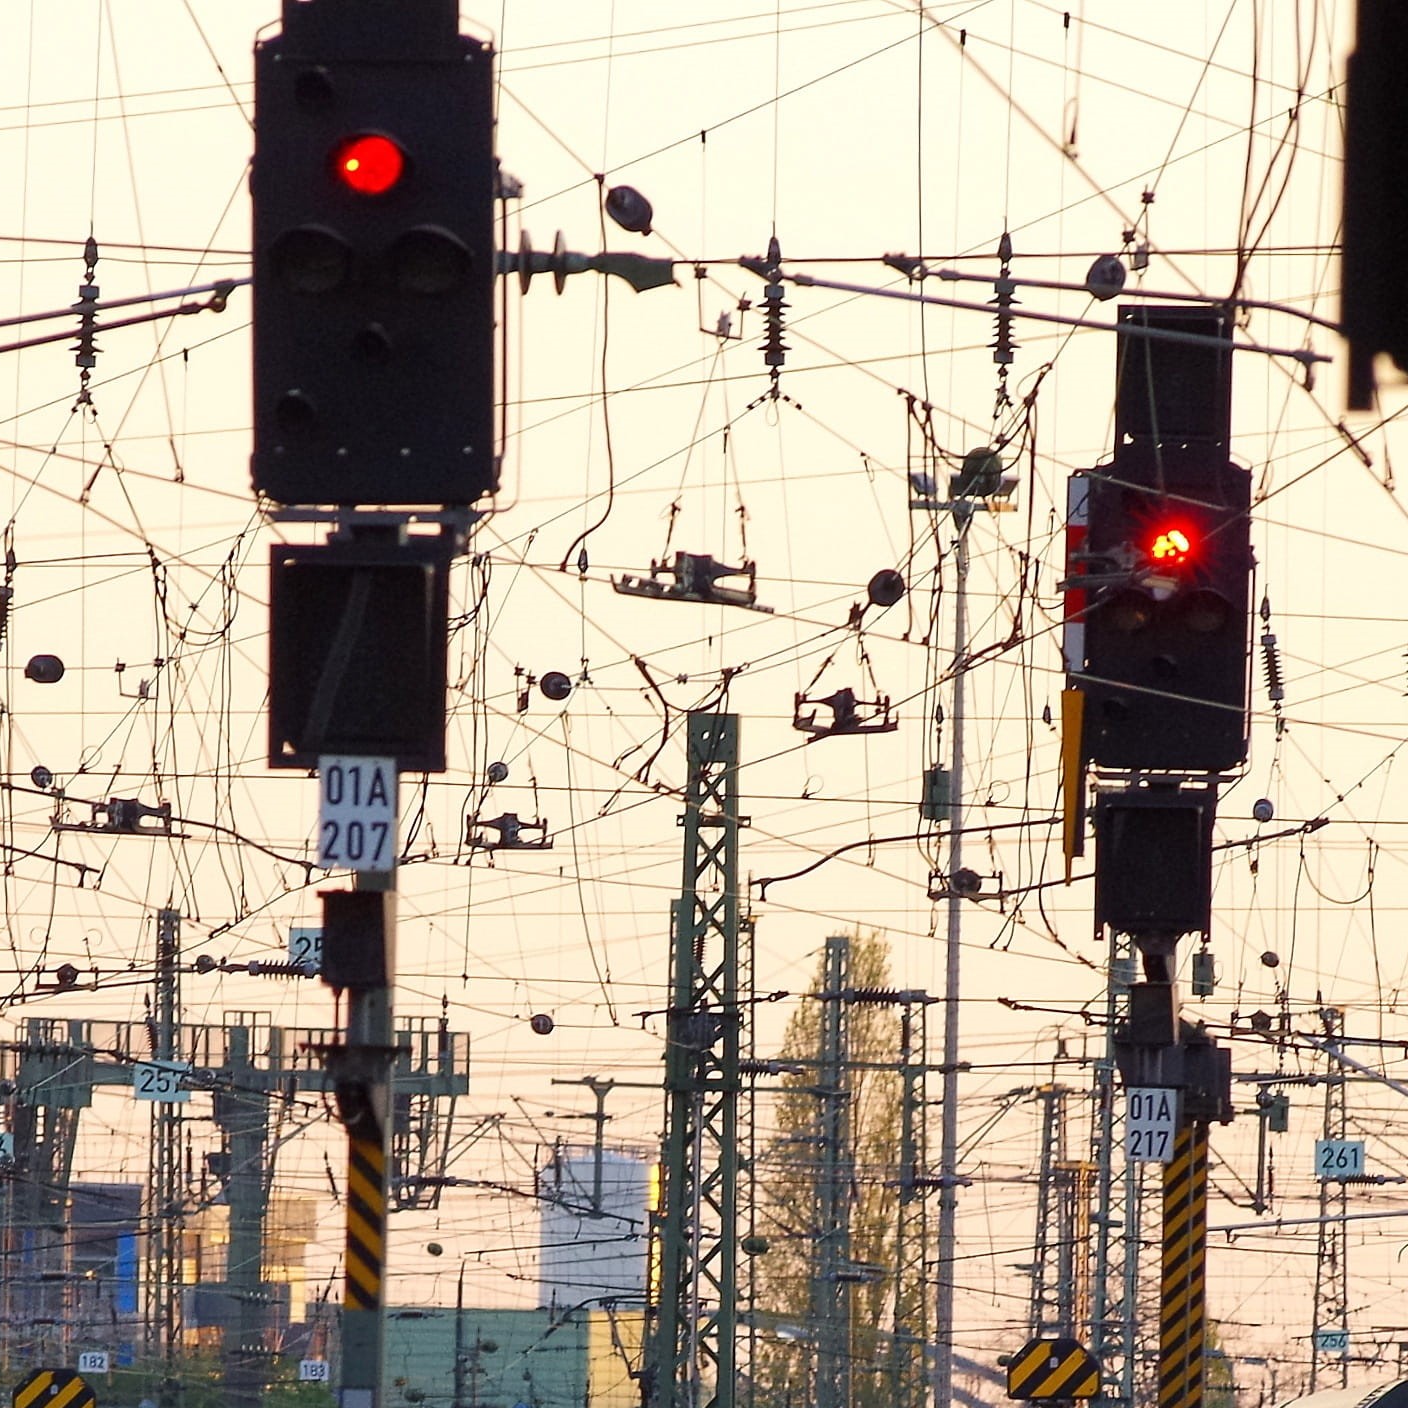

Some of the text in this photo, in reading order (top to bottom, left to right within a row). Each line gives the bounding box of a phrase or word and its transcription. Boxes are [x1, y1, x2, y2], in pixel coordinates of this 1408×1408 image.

[326, 766, 388, 807] 01A
[322, 821, 389, 862] 207
[1130, 1094, 1171, 1121] 01A
[1130, 1130, 1169, 1157] 217
[1322, 1147, 1358, 1169] 261
[82, 1355, 105, 1369] 182
